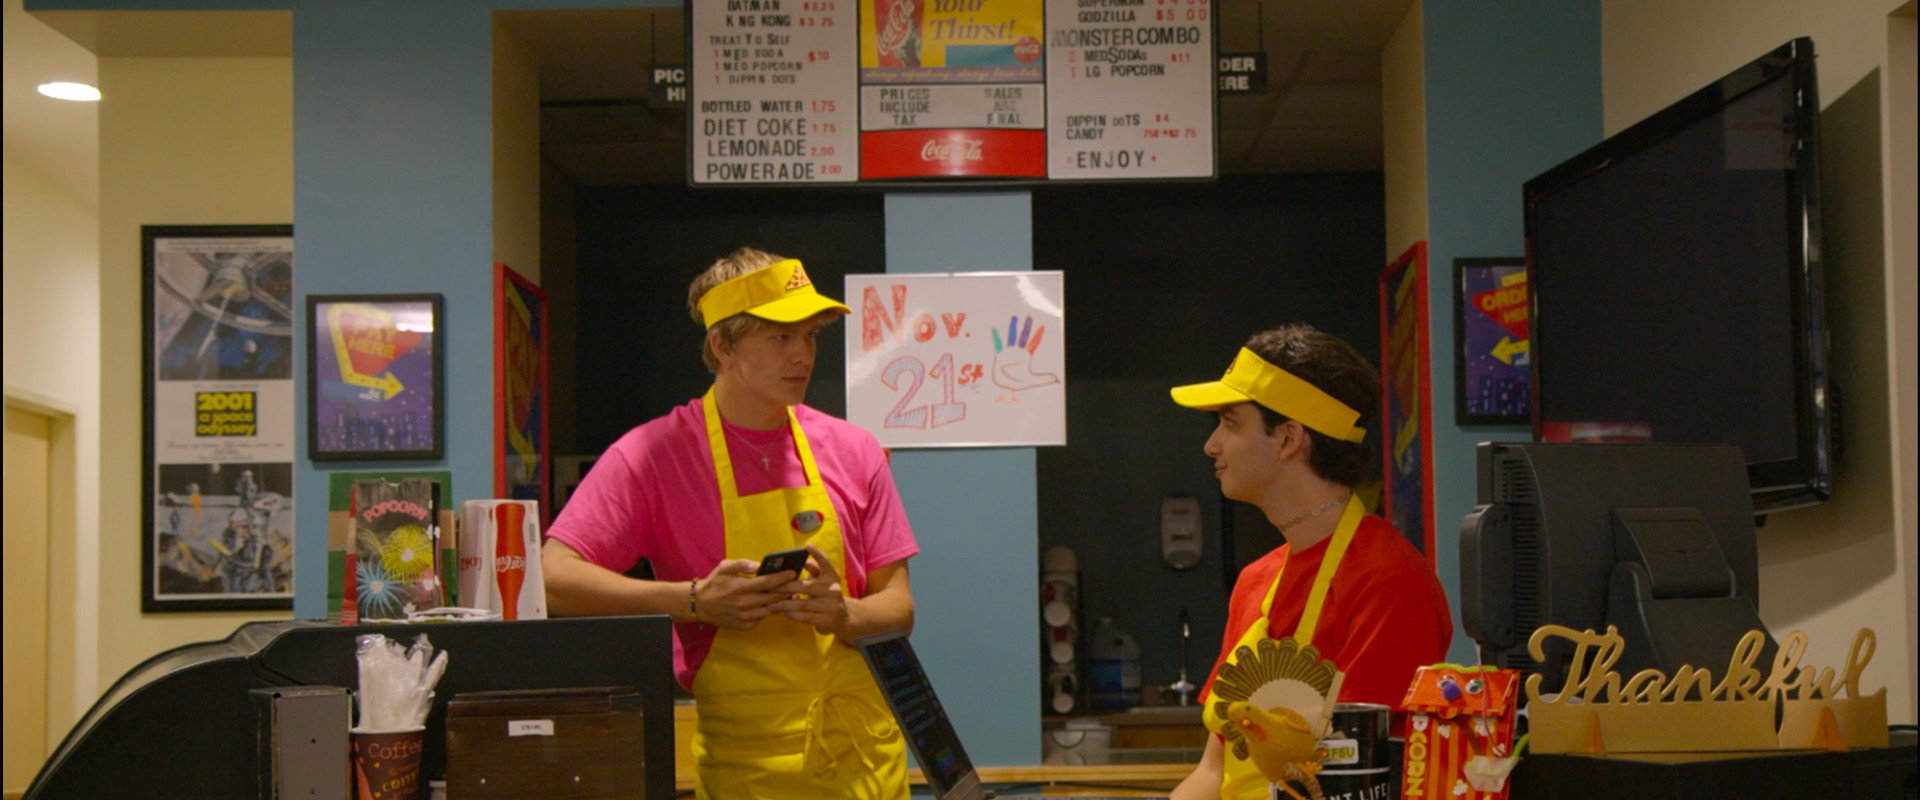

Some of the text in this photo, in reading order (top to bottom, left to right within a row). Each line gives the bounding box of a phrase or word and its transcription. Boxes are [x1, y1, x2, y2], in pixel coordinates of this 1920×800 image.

[728, 0, 780, 11] BATMAN
[761, 16, 791, 27] KONG
[1078, 10, 1136, 23] GODZILLA
[930, 18, 1016, 41] Thirst!
[710, 36, 741, 45] TREAT
[1051, 26, 1200, 48] MONSTER COMBO
[722, 49, 749, 60] MED
[1068, 51, 1076, 63] 2
[723, 62, 748, 71] MED
[752, 61, 802, 71] POPCORN
[1085, 66, 1100, 78] LG
[1110, 64, 1165, 77] POPCORN
[772, 75, 796, 84] DOTS
[880, 88, 930, 100] PRICES
[984, 87, 1022, 99] SALES
[701, 101, 751, 113] BOTTLED
[760, 101, 803, 112] WATER
[880, 101, 931, 113] INCLUDE
[894, 114, 916, 126] TAX
[1066, 114, 1106, 127] DIPPIN
[704, 118, 748, 137] DIET
[756, 118, 807, 137] COKE
[1066, 128, 1104, 141] CANDY
[707, 140, 806, 157] LEMONADE
[1076, 150, 1145, 169] ENJOY
[706, 163, 815, 181] POWERADE
[197, 393, 253, 411] 2001
[199, 412, 254, 425] a space
[197, 423, 256, 436] odyssey
[363, 500, 428, 523] POPCORN
[1525, 624, 1888, 708] Thankful
